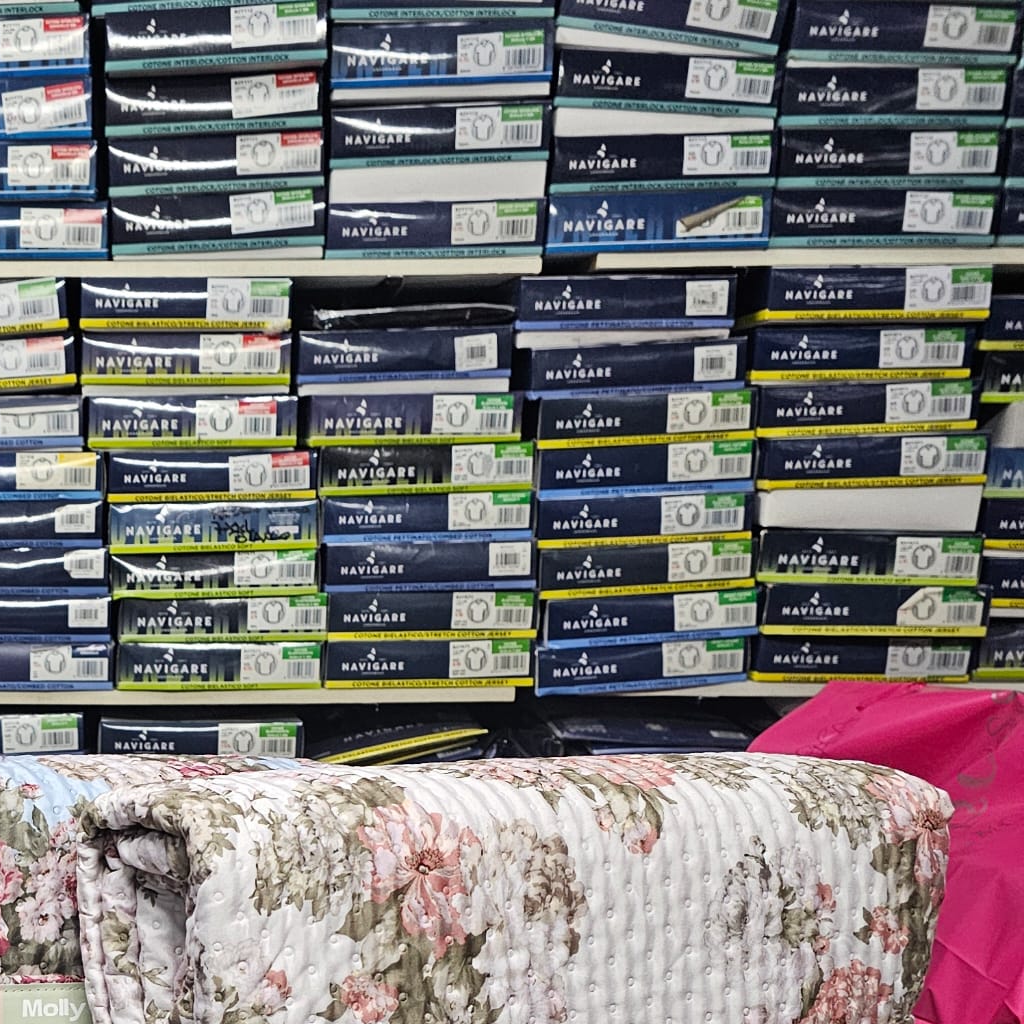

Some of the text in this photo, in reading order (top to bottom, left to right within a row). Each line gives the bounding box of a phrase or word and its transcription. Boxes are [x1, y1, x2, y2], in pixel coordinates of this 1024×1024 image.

[809, 26, 879, 37] NAVIGARE
[573, 74, 641, 86] NAVIGARE
[798, 92, 868, 102] NAVIGARE
[345, 134, 411, 145] NAVIGARE
[569, 158, 637, 170] NAVIGARE
[795, 153, 864, 164] NAVIGARE
[786, 213, 856, 223] NAVIGARE
[563, 218, 645, 232] NAVIGARE
[342, 226, 408, 237] NAVIGARE
[785, 290, 853, 300] NAVIGARE
[95, 298, 159, 308] NAVIGARE
[535, 300, 601, 310] NAVIGARE
[314, 354, 378, 364] NAVIGARE
[771, 351, 837, 360] NAVIGARE
[96, 356, 172, 368] NAVIGARE
[546, 368, 611, 380] NAVIGARE
[776, 406, 843, 417] NAVIGARE
[102, 419, 178, 431] NAVIGARE
[325, 418, 402, 429] NAVIGARE
[556, 418, 621, 429] NAVIGARE
[785, 459, 852, 470] NAVIGARE
[124, 474, 187, 483] NAVIGARE
[337, 467, 415, 479] NAVIGARE
[556, 468, 621, 480] NAVIGARE
[339, 514, 402, 525] NAVIGARE
[553, 519, 618, 530] NAVIGARE
[126, 524, 201, 536] NAVIGARE
[778, 554, 859, 566] NAVIGARE
[341, 565, 404, 575] NAVIGARE
[557, 568, 621, 580] NAVIGARE
[782, 607, 849, 616] NAVIGARE
[137, 617, 212, 627] NAVIGARE
[344, 613, 406, 623] NAVIGARE
[563, 617, 628, 629] NAVIGARE
[774, 655, 839, 664] NAVIGARE
[134, 664, 208, 674] NAVIGARE
[342, 662, 404, 672] NAVIGARE
[553, 665, 617, 677] NAVIGARE
[115, 741, 174, 750] NAVIGARE
[22, 999, 86, 1021] Molly
